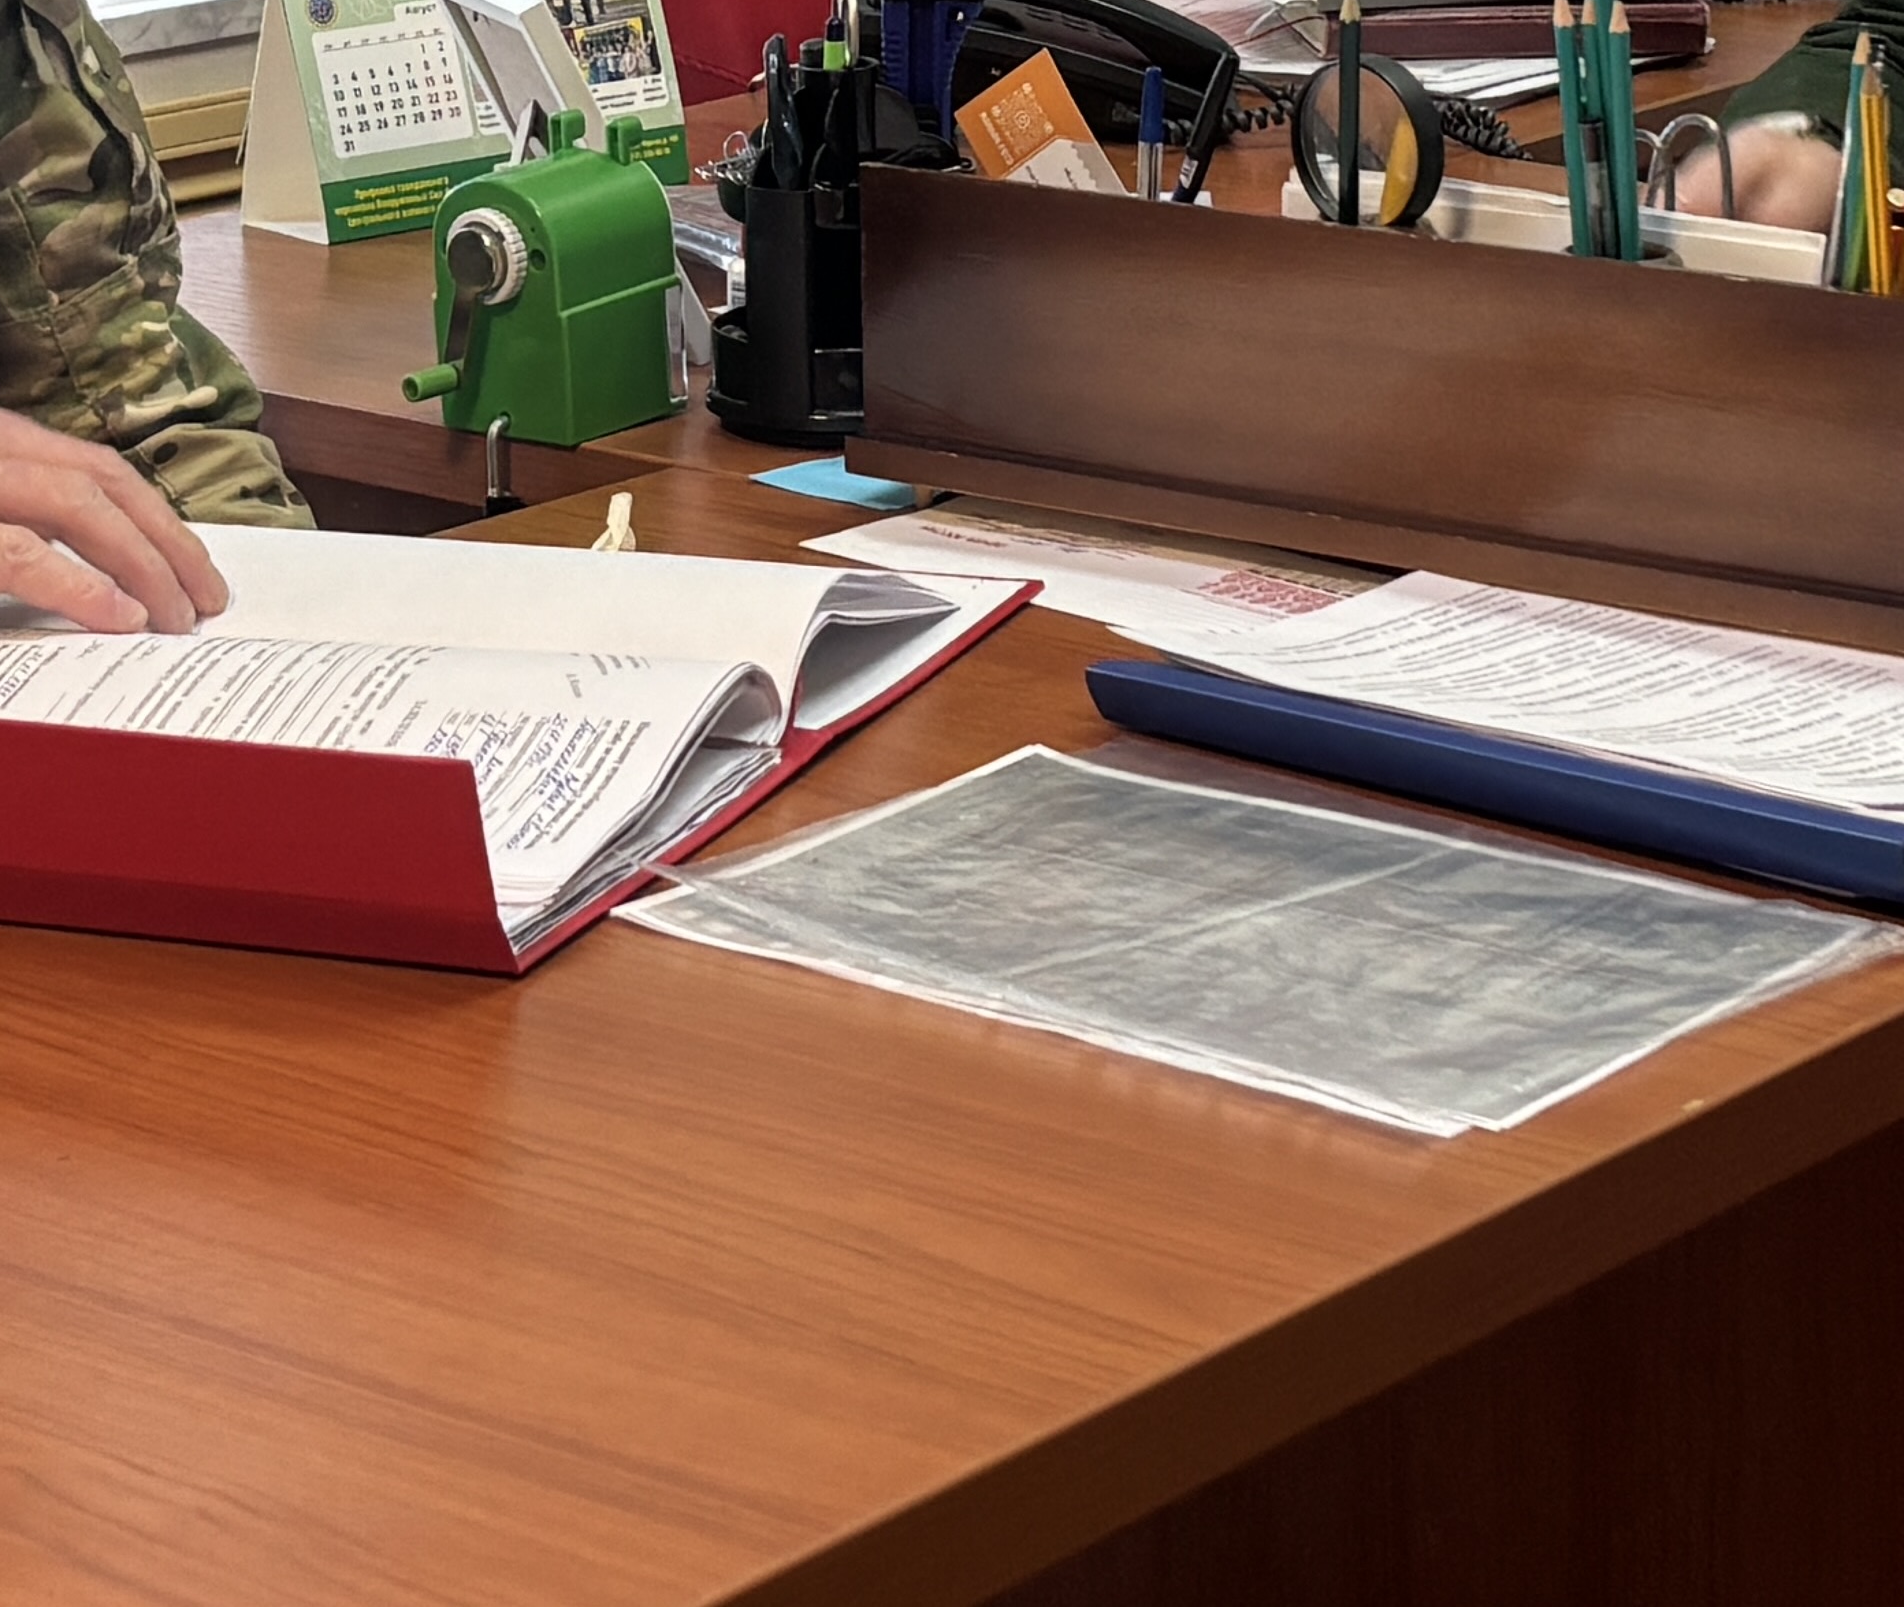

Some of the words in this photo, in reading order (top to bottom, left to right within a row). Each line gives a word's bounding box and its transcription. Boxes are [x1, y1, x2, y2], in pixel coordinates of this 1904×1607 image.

[420, 43, 426, 55] 1
[437, 40, 445, 53] 2
[332, 73, 340, 86] 3
[350, 70, 359, 82] 4
[387, 65, 395, 77] 6
[404, 62, 413, 75] 7
[332, 89, 346, 102] 10
[352, 86, 363, 99] 11
[370, 83, 383, 97] 12
[387, 81, 401, 94] 13
[405, 78, 419, 91] 14
[424, 75, 436, 88] 15
[442, 72, 454, 85] 16
[336, 105, 348, 119] 17
[354, 102, 368, 116] 18
[372, 100, 385, 113] 19
[390, 97, 405, 111] 20
[410, 94, 422, 108] 21
[426, 91, 441, 105] 22
[444, 89, 459, 103] 23
[339, 122, 354, 137] 24
[357, 119, 372, 134] 25
[376, 116, 389, 131] 26
[393, 113, 407, 128] 27
[412, 110, 426, 125] 28
[430, 108, 443, 122] 29
[448, 105, 462, 119] 30
[343, 139, 356, 153] 31
